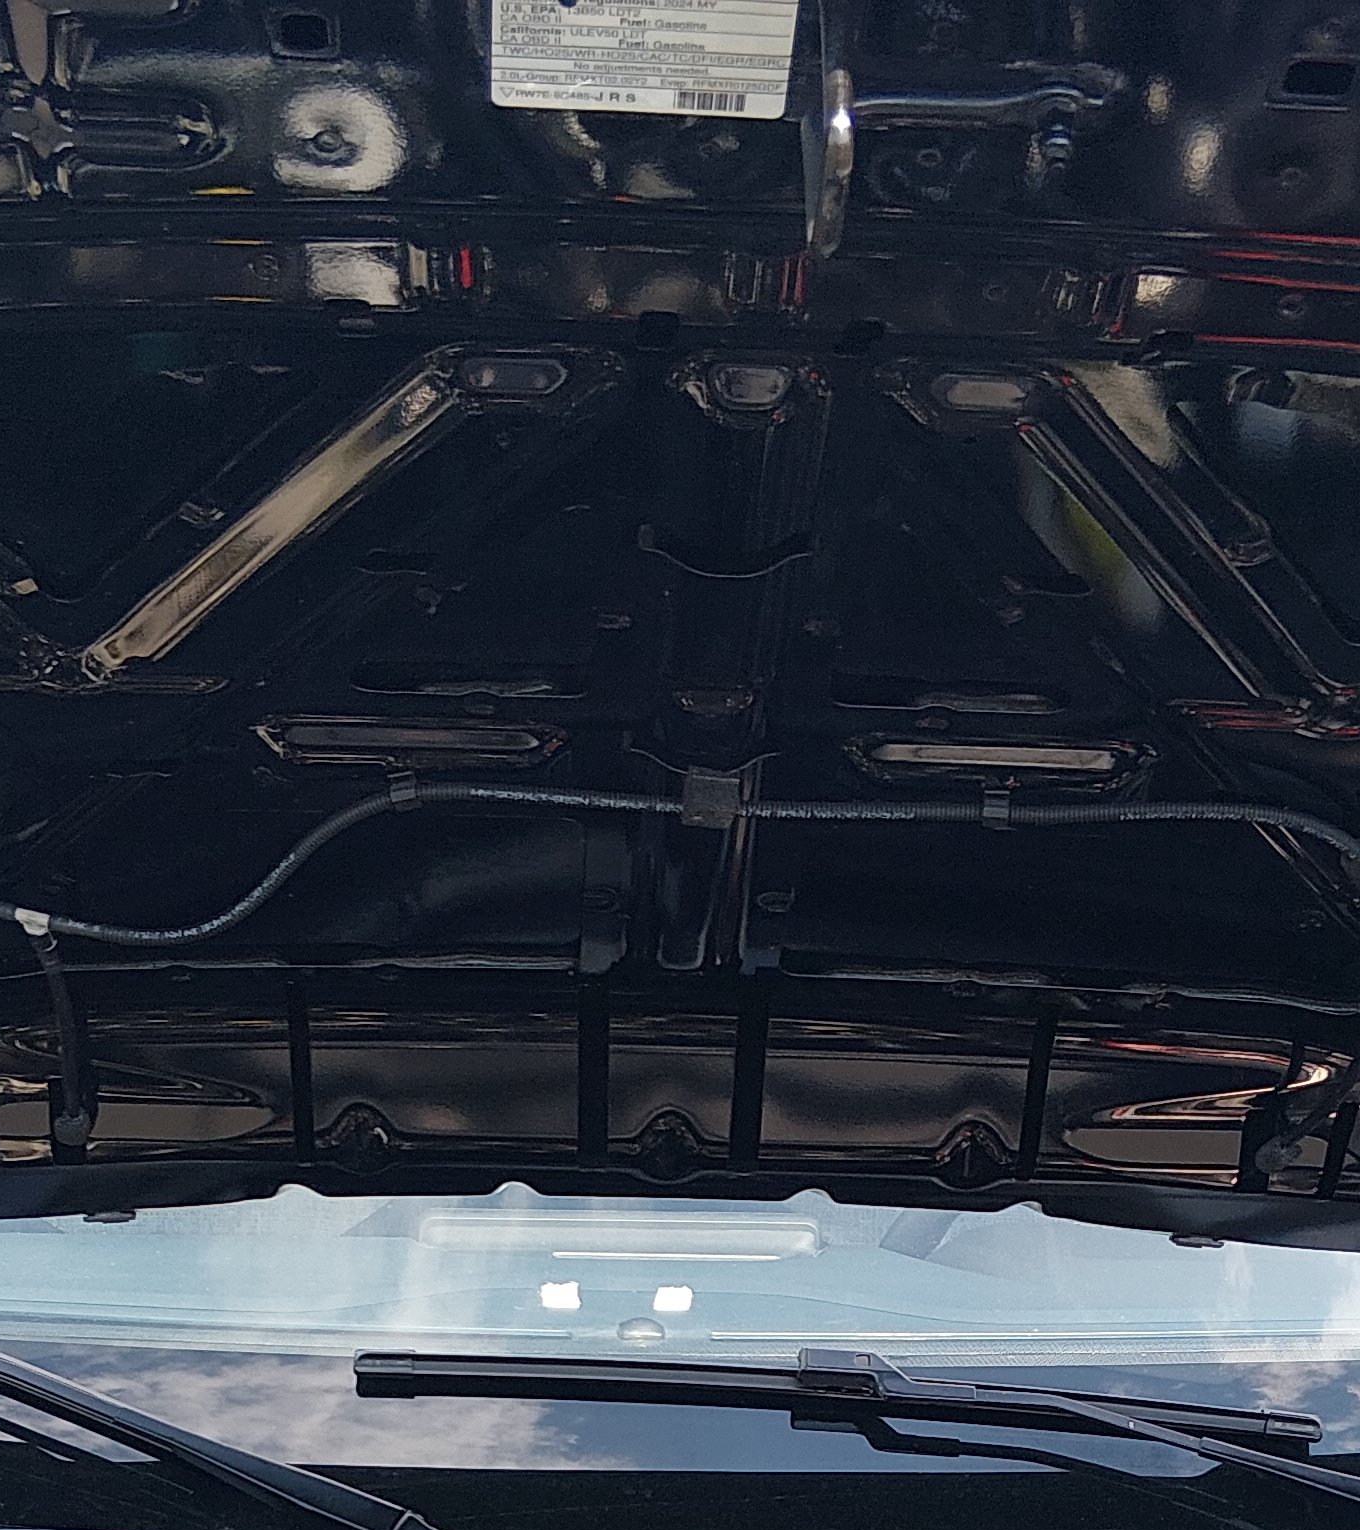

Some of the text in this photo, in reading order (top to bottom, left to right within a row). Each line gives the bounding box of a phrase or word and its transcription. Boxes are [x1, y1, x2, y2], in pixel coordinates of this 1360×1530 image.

[500, 14, 518, 22] CA
[522, 14, 551, 23] OBD
[619, 18, 651, 28] Fuel:
[654, 19, 708, 31] Gasoline
[500, 24, 566, 36] California:
[500, 34, 518, 43] CA
[521, 35, 551, 44] OBD
[618, 39, 649, 49] Fuel:
[653, 40, 706, 51] Gasoline
[573, 62, 590, 70] No
[593, 63, 663, 75] adjustments
